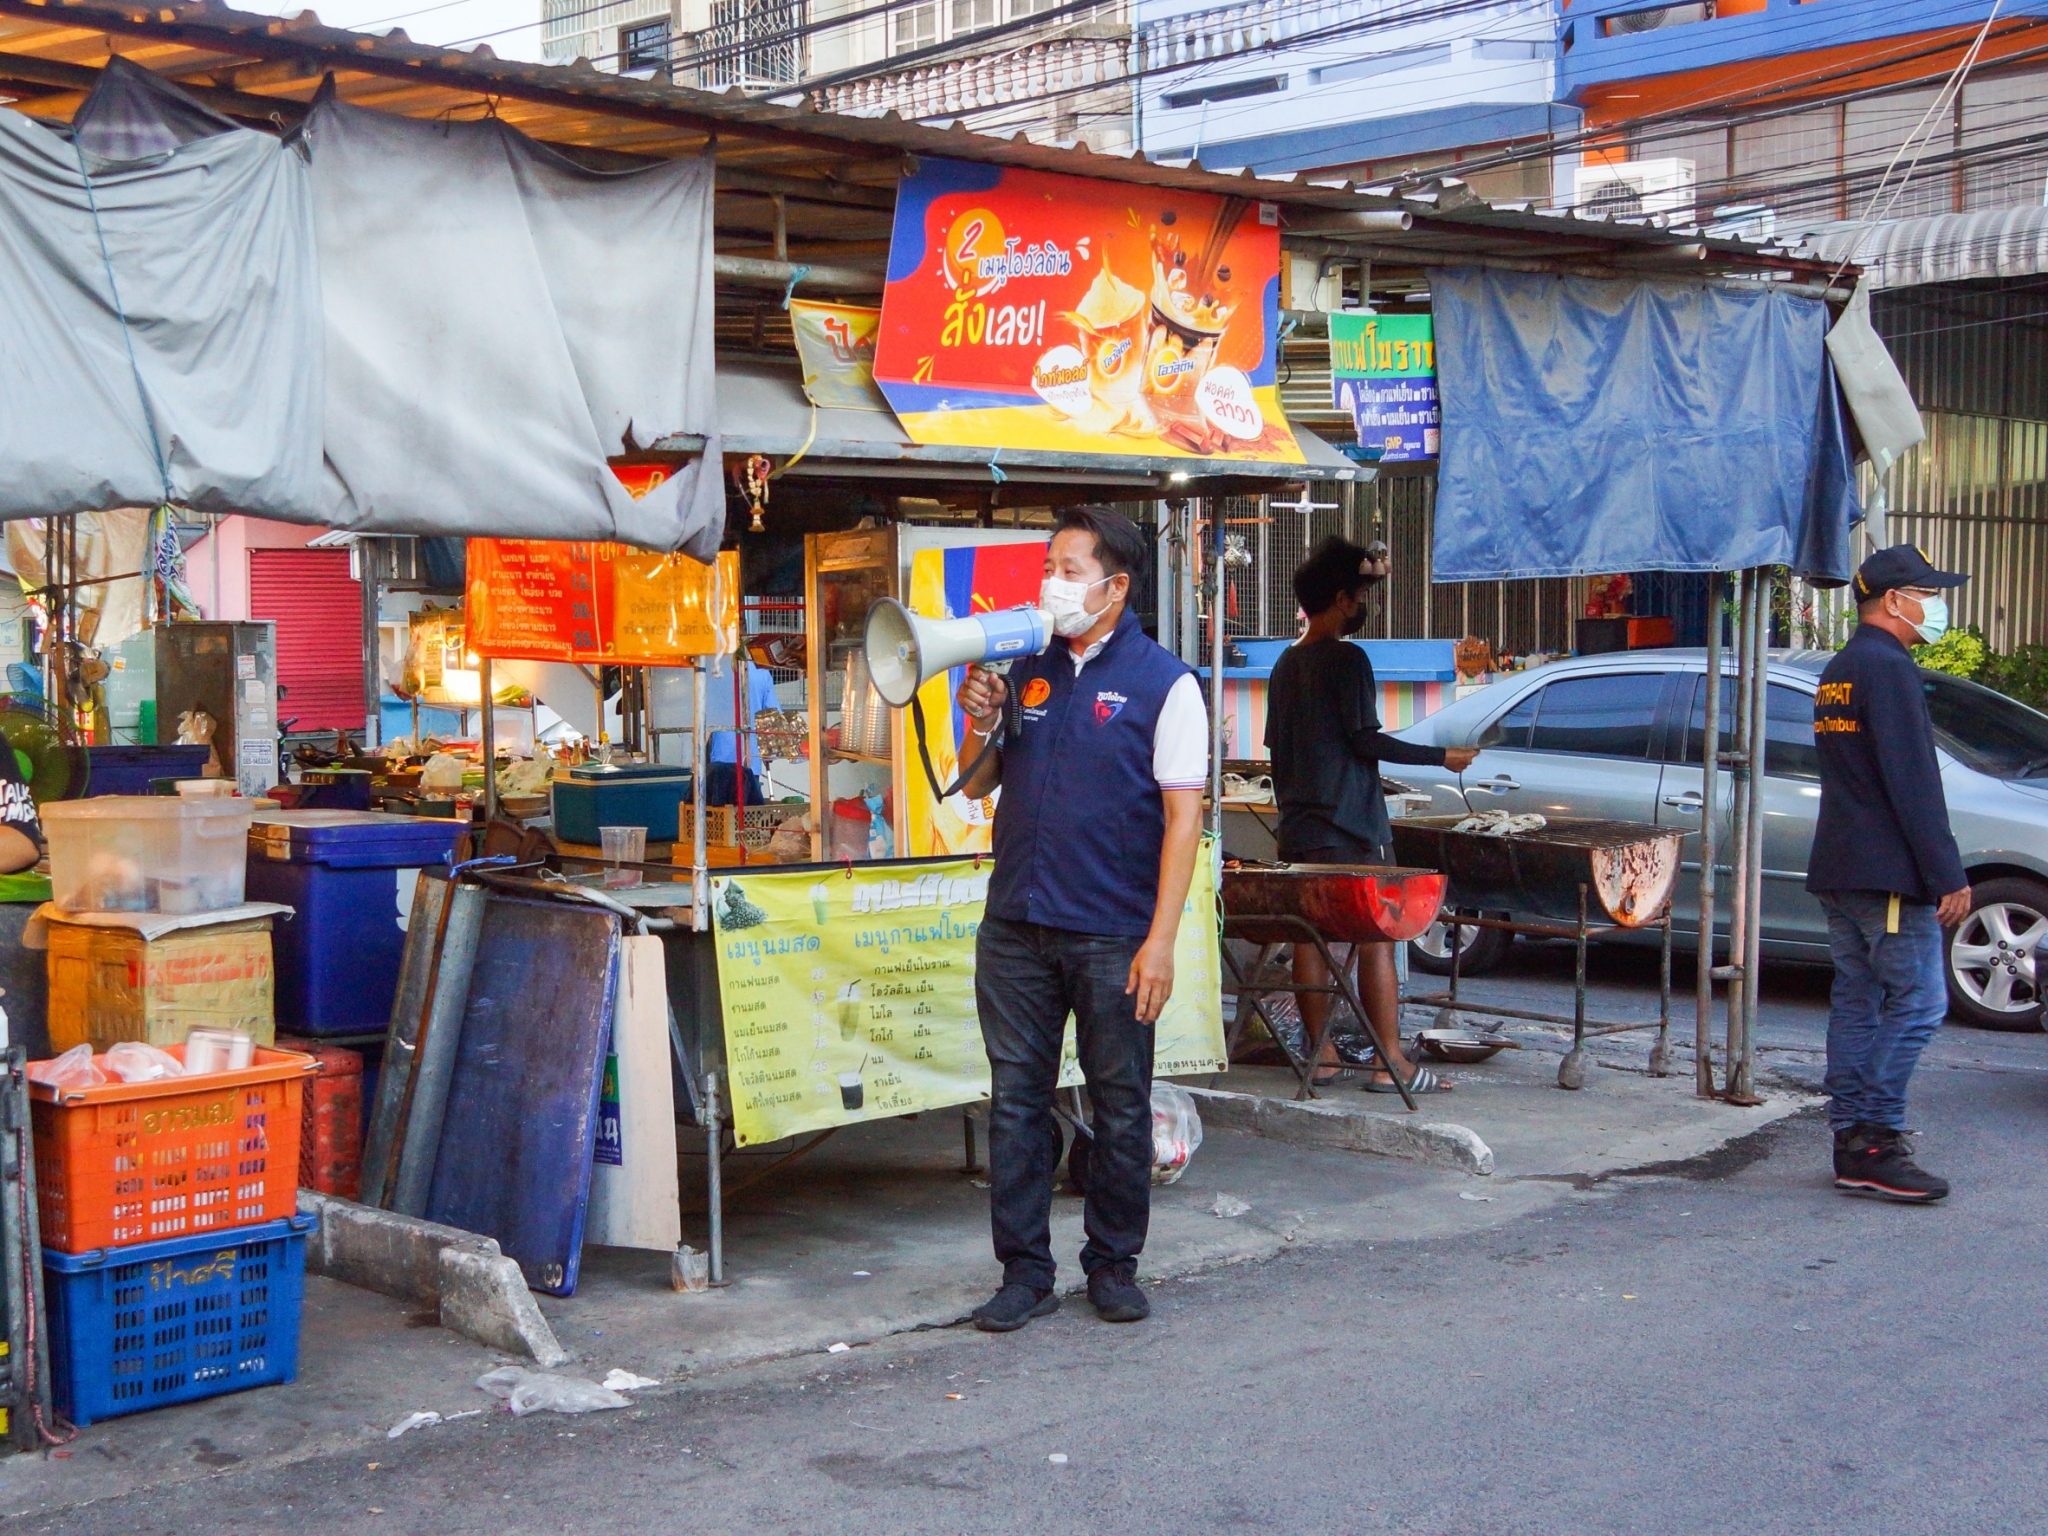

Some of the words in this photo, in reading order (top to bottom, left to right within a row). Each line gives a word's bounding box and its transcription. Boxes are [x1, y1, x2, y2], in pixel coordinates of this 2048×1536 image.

[957, 219, 985, 263] 2
[977, 236, 1073, 287] เมนูโอวัลติน
[941, 271, 1047, 348] สั่งเลย!
[1033, 357, 1090, 389] ไวท์มอลต์
[1213, 399, 1256, 426] ลาวา
[855, 911, 979, 955] เมนูกาแฟโบร
